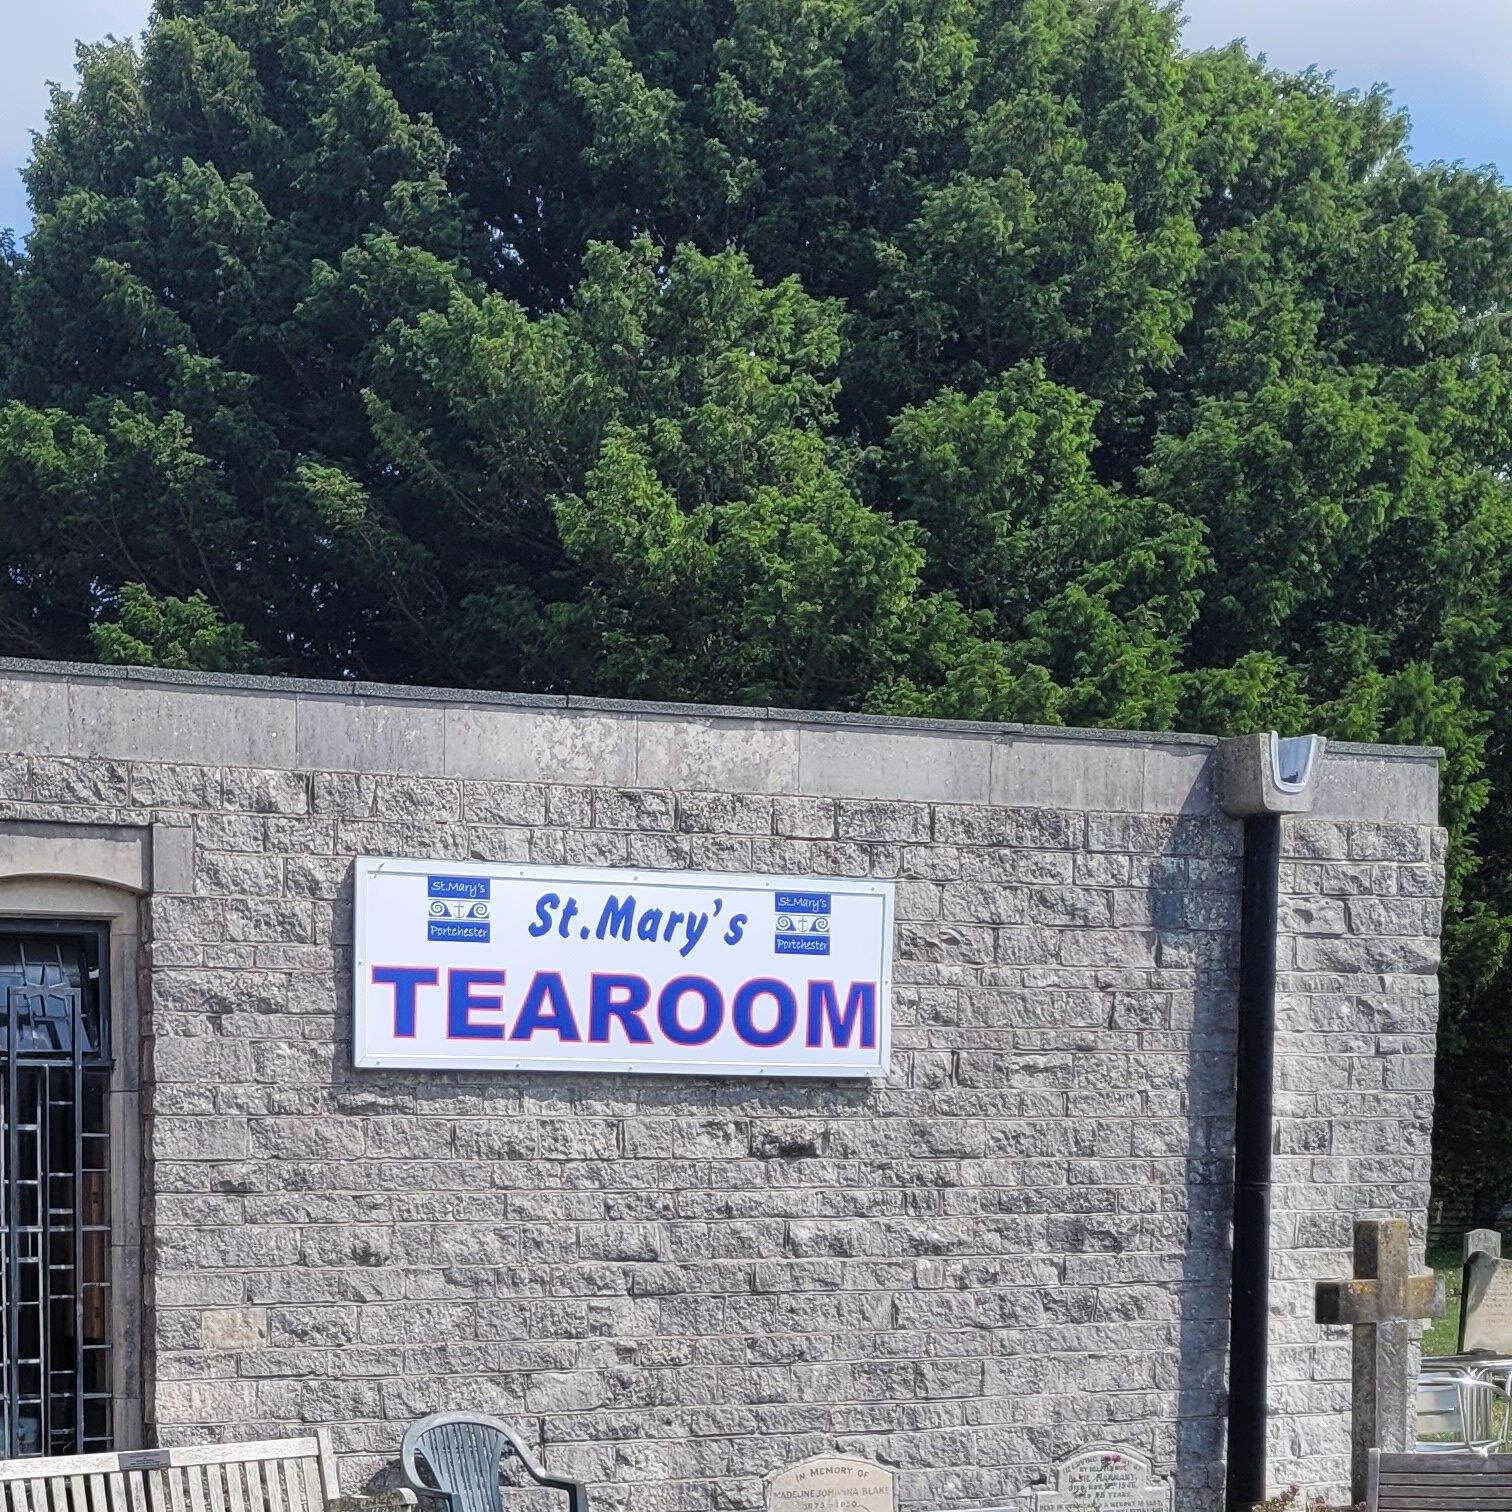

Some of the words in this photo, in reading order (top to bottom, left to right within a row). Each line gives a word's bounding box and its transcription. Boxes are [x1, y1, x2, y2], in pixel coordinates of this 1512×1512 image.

[430, 880, 486, 898] St.Mary's
[777, 896, 827, 912] St.Mary's
[430, 925, 488, 938] Portchester
[528, 892, 747, 957] St.Mary's
[776, 938, 827, 950] Portchester
[371, 964, 877, 1050] TEAROOM
[795, 1472, 806, 1482] IN
[810, 1467, 853, 1477] MEMORY
[857, 1469, 869, 1478] OF
[862, 1487, 889, 1496] BLAKE
